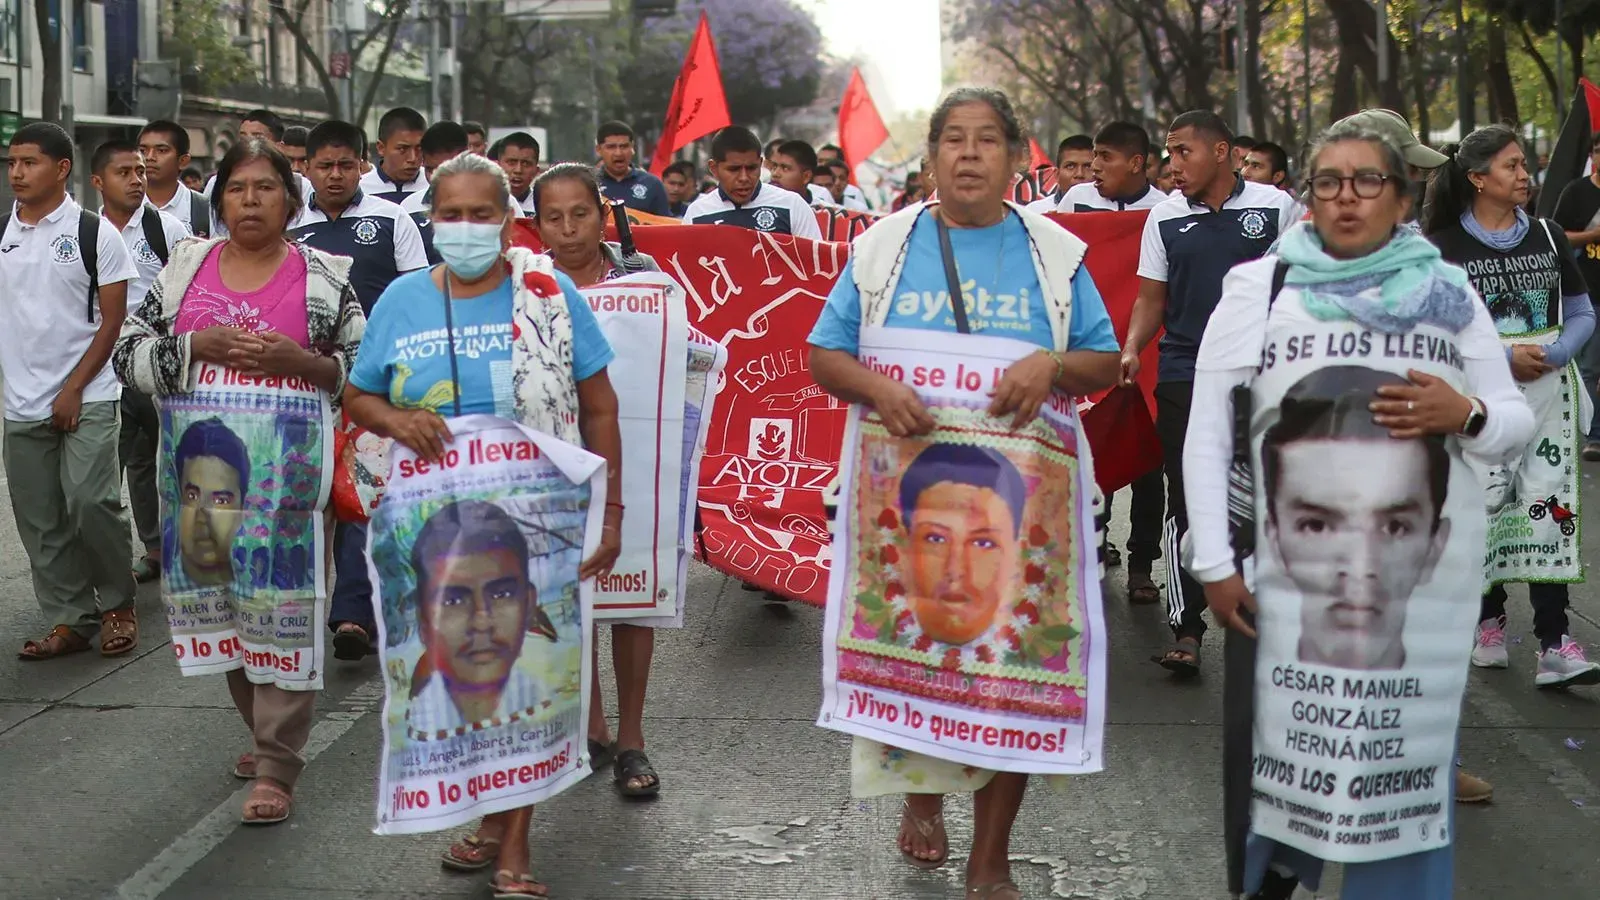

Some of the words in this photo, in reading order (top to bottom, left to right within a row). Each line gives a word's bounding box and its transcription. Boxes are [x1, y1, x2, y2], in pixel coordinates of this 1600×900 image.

[1286, 334, 1315, 362] SE
[1325, 331, 1372, 357] LOS
[198, 363, 216, 385] lo
[913, 366, 946, 388] se
[955, 364, 981, 391] lo
[1536, 438, 1561, 467] 43
[399, 458, 430, 478] se
[182, 603, 209, 615] ALEN
[260, 614, 274, 626] LA
[280, 615, 308, 629] CRUZ
[191, 637, 212, 658] lo
[901, 665, 970, 693] TRUJILLO
[1272, 665, 1335, 696] CÉSAR
[1343, 678, 1423, 700] MANUEL
[847, 689, 899, 723] ¡Vivo
[904, 702, 923, 729] lo
[930, 714, 1068, 753] queremos!
[1292, 700, 1400, 731] GONZÁLEZ
[471, 734, 514, 752] Abarca
[1286, 728, 1405, 762] HERNÁNDEZ
[392, 785, 430, 818] ¡Vivo
[437, 780, 462, 805] lo
[467, 741, 572, 801] queremos!
[1300, 767, 1337, 796] LOS
[1347, 765, 1438, 800] QUEREMOS!
[1337, 813, 1355, 827] DE
[1389, 809, 1399, 822] LA
